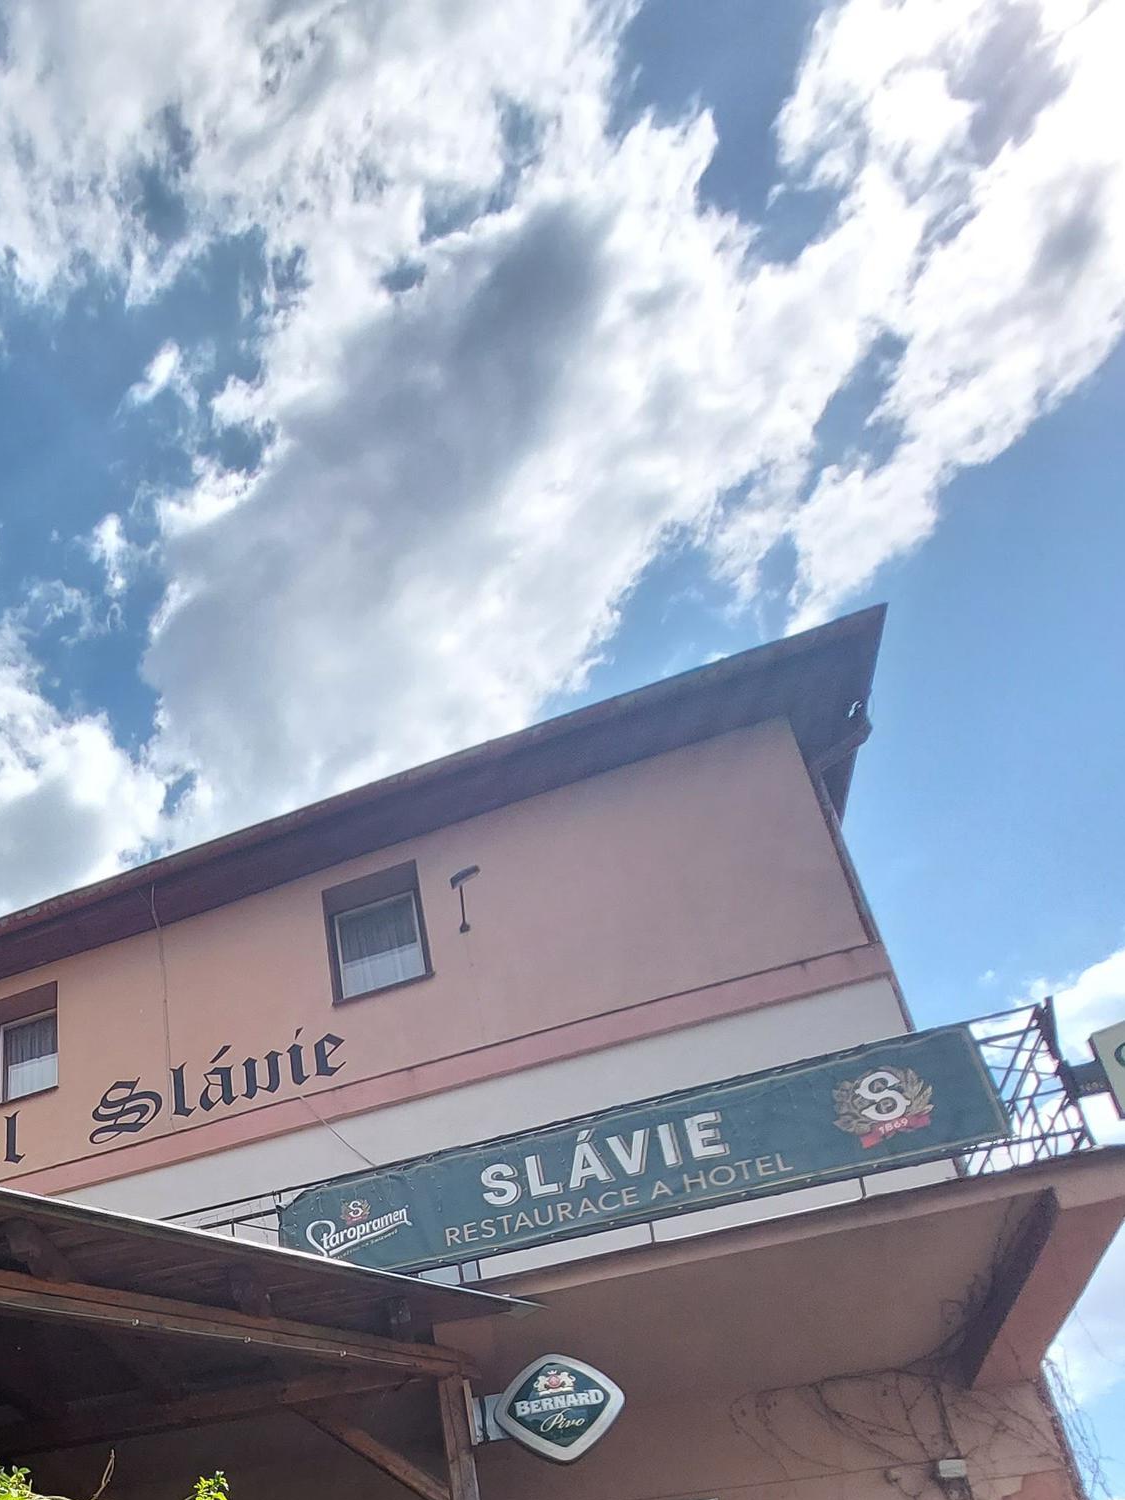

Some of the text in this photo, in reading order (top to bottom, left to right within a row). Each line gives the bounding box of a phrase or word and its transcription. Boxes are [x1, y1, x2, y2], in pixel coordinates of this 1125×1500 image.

[878, 1117, 909, 1135] 1869
[480, 1111, 730, 1206] SLÁVIE
[444, 1188, 640, 1247] RESTAURACE
[651, 1180, 673, 1200] A
[682, 1153, 794, 1193] HOTEL
[306, 1207, 413, 1257] Staropramen
[514, 1389, 605, 1418] BERNARD
[540, 1408, 585, 1432] Pivo
